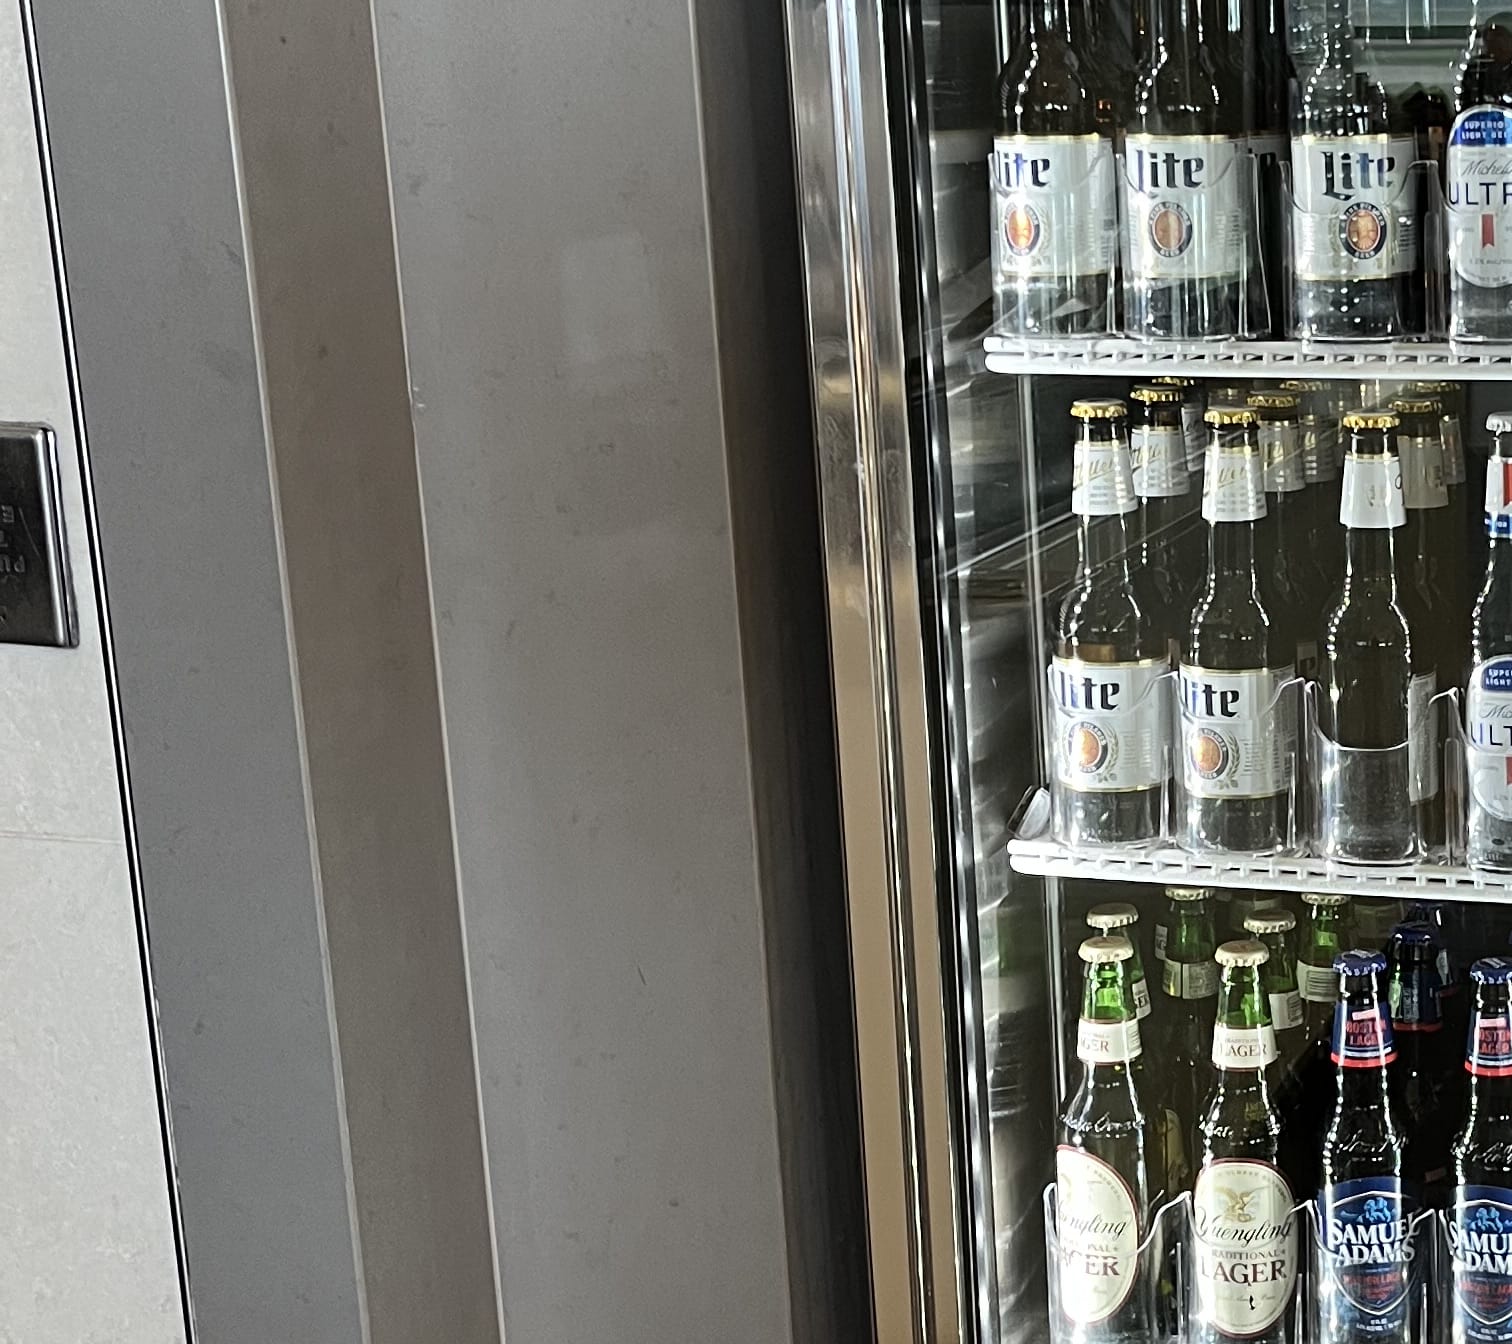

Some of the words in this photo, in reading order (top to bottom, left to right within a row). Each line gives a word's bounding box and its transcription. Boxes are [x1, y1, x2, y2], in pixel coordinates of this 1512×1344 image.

[1320, 150, 1396, 202] Lite
[1485, 677, 1512, 687] LIGHT
[1196, 1207, 1292, 1249] Yuengling
[1328, 1212, 1421, 1251] SAMUEL
[1334, 1238, 1416, 1267] ADAMS
[1201, 1260, 1288, 1287] LAGER
